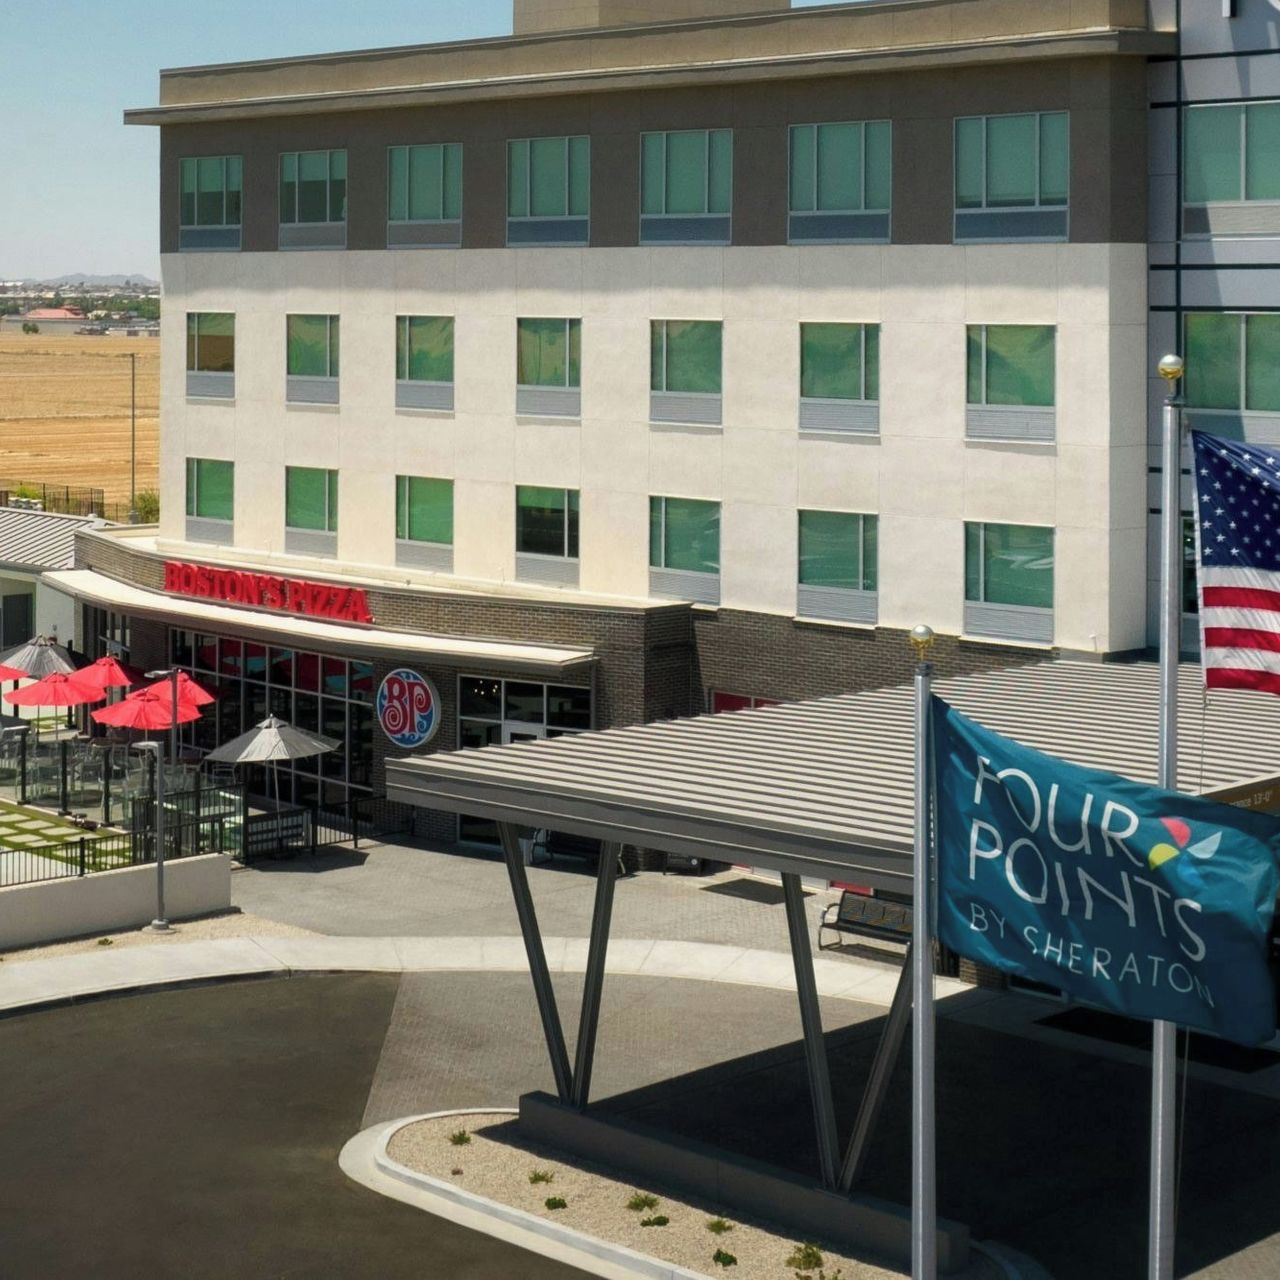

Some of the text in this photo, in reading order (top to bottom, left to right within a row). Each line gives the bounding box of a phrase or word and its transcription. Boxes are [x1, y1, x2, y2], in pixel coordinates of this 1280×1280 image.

[164, 561, 371, 624] BOSTON'S PIZZA
[381, 675, 432, 736] BP
[972, 756, 1145, 867] FOUR
[969, 817, 1207, 962] POINTS
[970, 901, 1215, 1008] BY SHERATON
